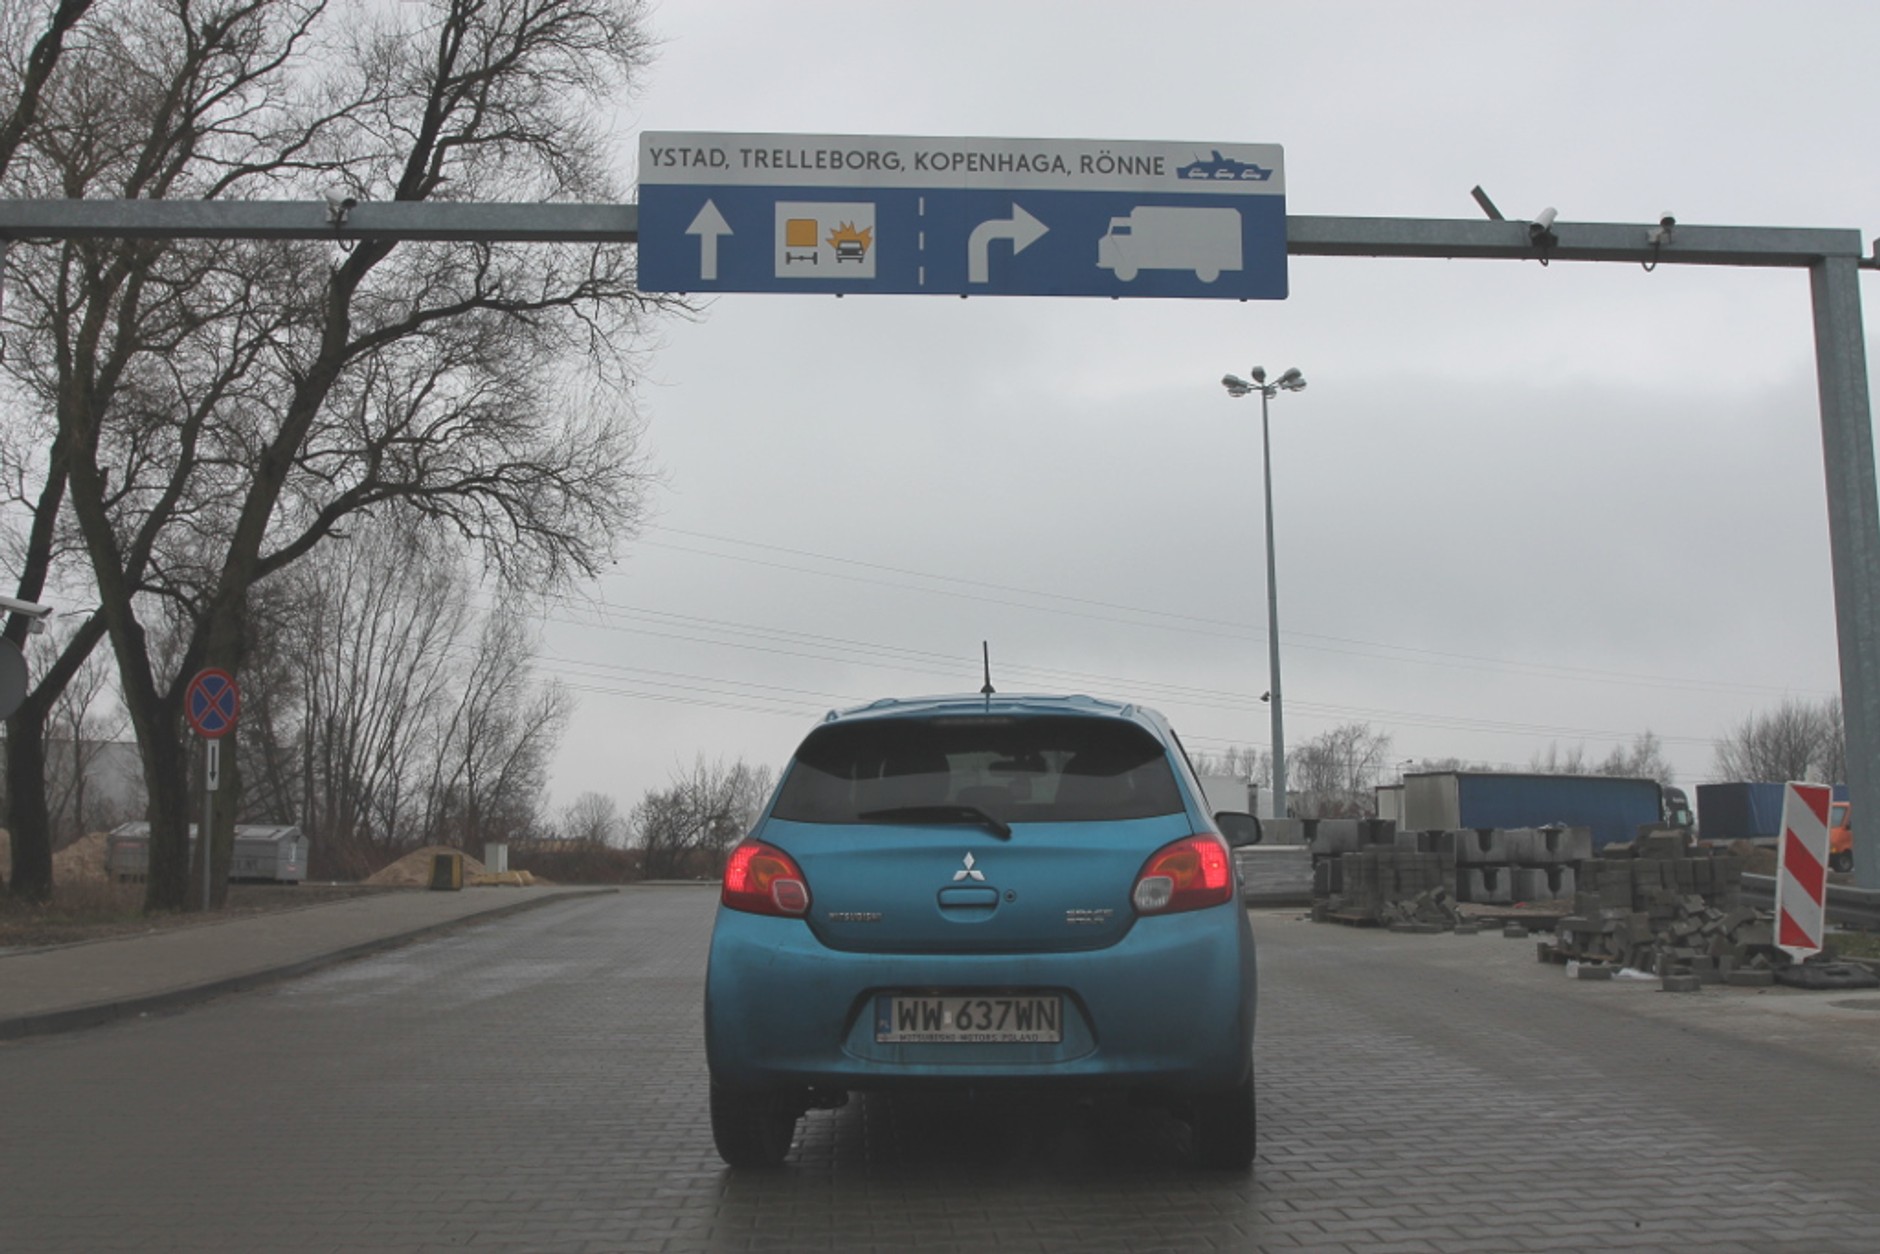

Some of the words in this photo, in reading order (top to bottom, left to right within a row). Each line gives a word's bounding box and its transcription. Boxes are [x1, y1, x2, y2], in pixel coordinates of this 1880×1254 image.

[650, 148, 730, 170] YSTAD,
[740, 149, 905, 172] TRELLEBORG,
[914, 152, 1071, 177] KOPENHAGA,
[1080, 150, 1165, 175] RÖNNE
[898, 1001, 943, 1031] WW
[955, 1001, 1055, 1031] 637WN
